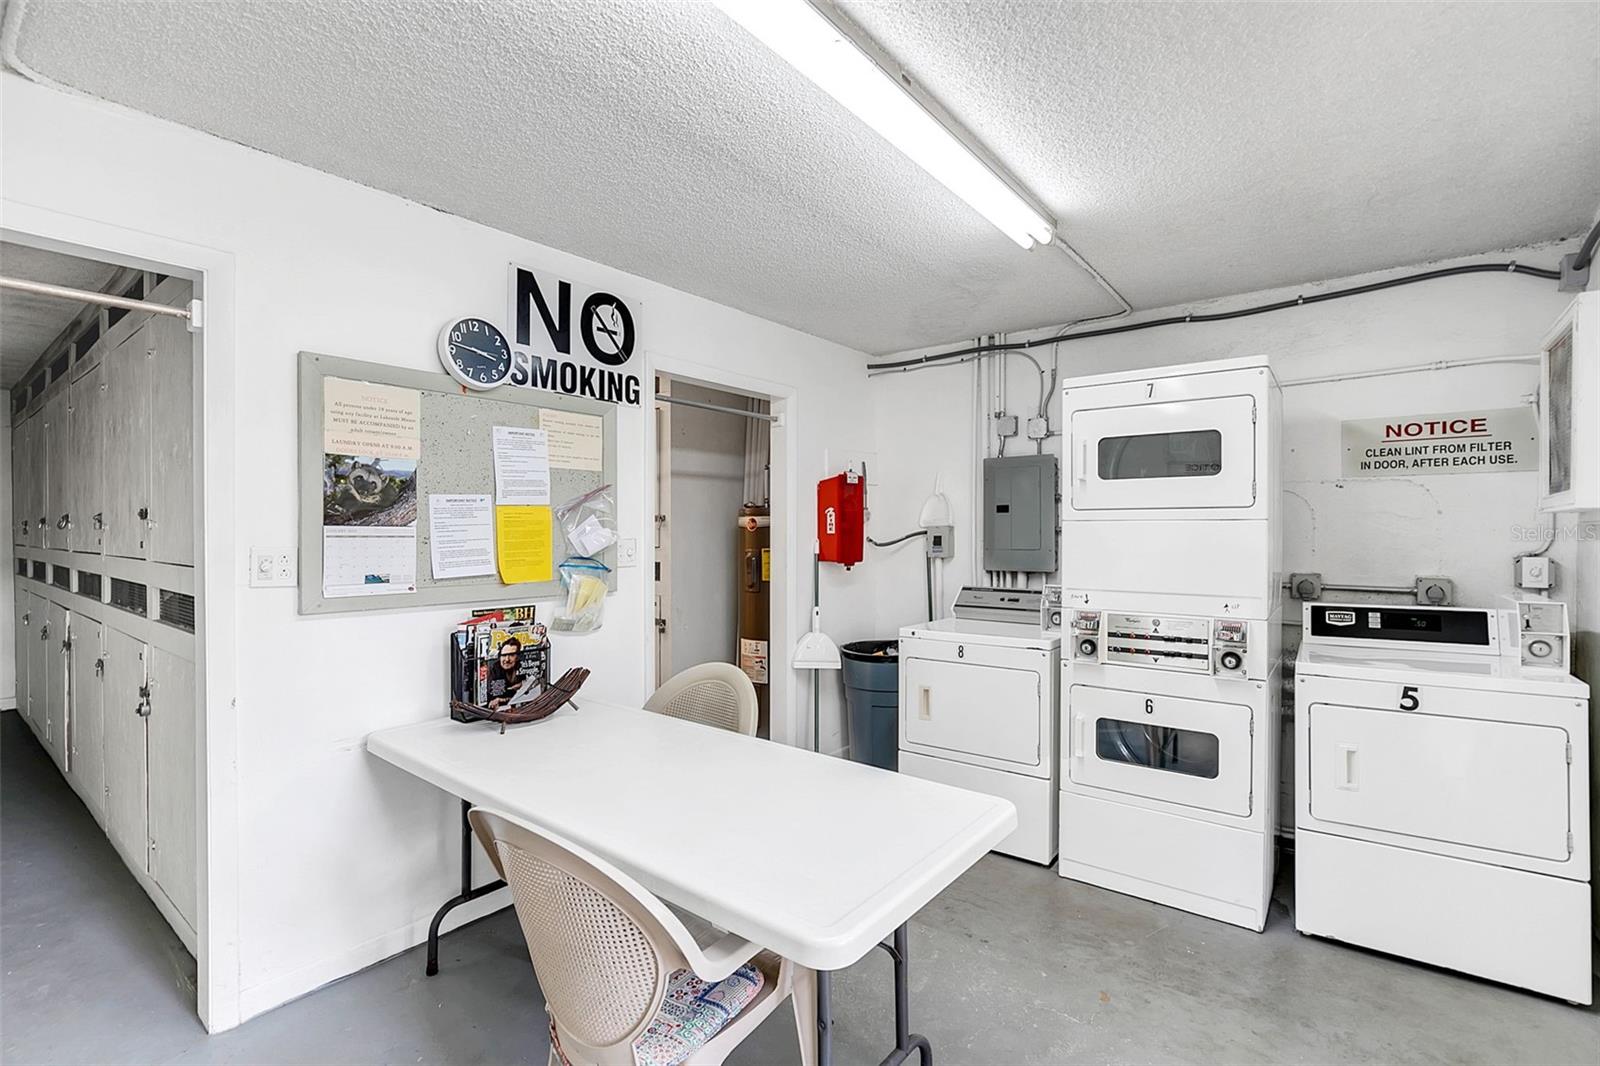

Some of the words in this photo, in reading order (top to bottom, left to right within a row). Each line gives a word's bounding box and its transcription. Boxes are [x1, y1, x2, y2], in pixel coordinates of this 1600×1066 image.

[516, 267, 635, 366] NO
[460, 322, 467, 334] 11
[469, 320, 479, 332] 12
[485, 325, 489, 336] 1
[451, 331, 462, 342] 10
[494, 336, 501, 346] 2
[448, 344, 456, 355] 9
[501, 349, 508, 359] 3
[456, 359, 464, 369] 8
[498, 362, 505, 372] 4
[467, 368, 473, 377] 7
[480, 372, 487, 382] 6
[492, 369, 498, 380] 5
[510, 351, 640, 405] SMOKING
[1147, 383, 1154, 398] 7
[1386, 418, 1488, 438] NOTICE
[1365, 447, 1402, 458] CLEAN
[1405, 445, 1430, 456] LINT
[1433, 443, 1466, 455] FROM
[1470, 441, 1512, 452] FILTER
[1360, 460, 1371, 470] IN
[1374, 459, 1409, 471] DOOR,
[1412, 457, 1449, 468] AFTER
[1453, 455, 1486, 466] EACH
[1489, 454, 1518, 465] USE.
[957, 645, 964, 658] 8
[1400, 686, 1419, 711] 5
[1145, 699, 1153, 714] 6
